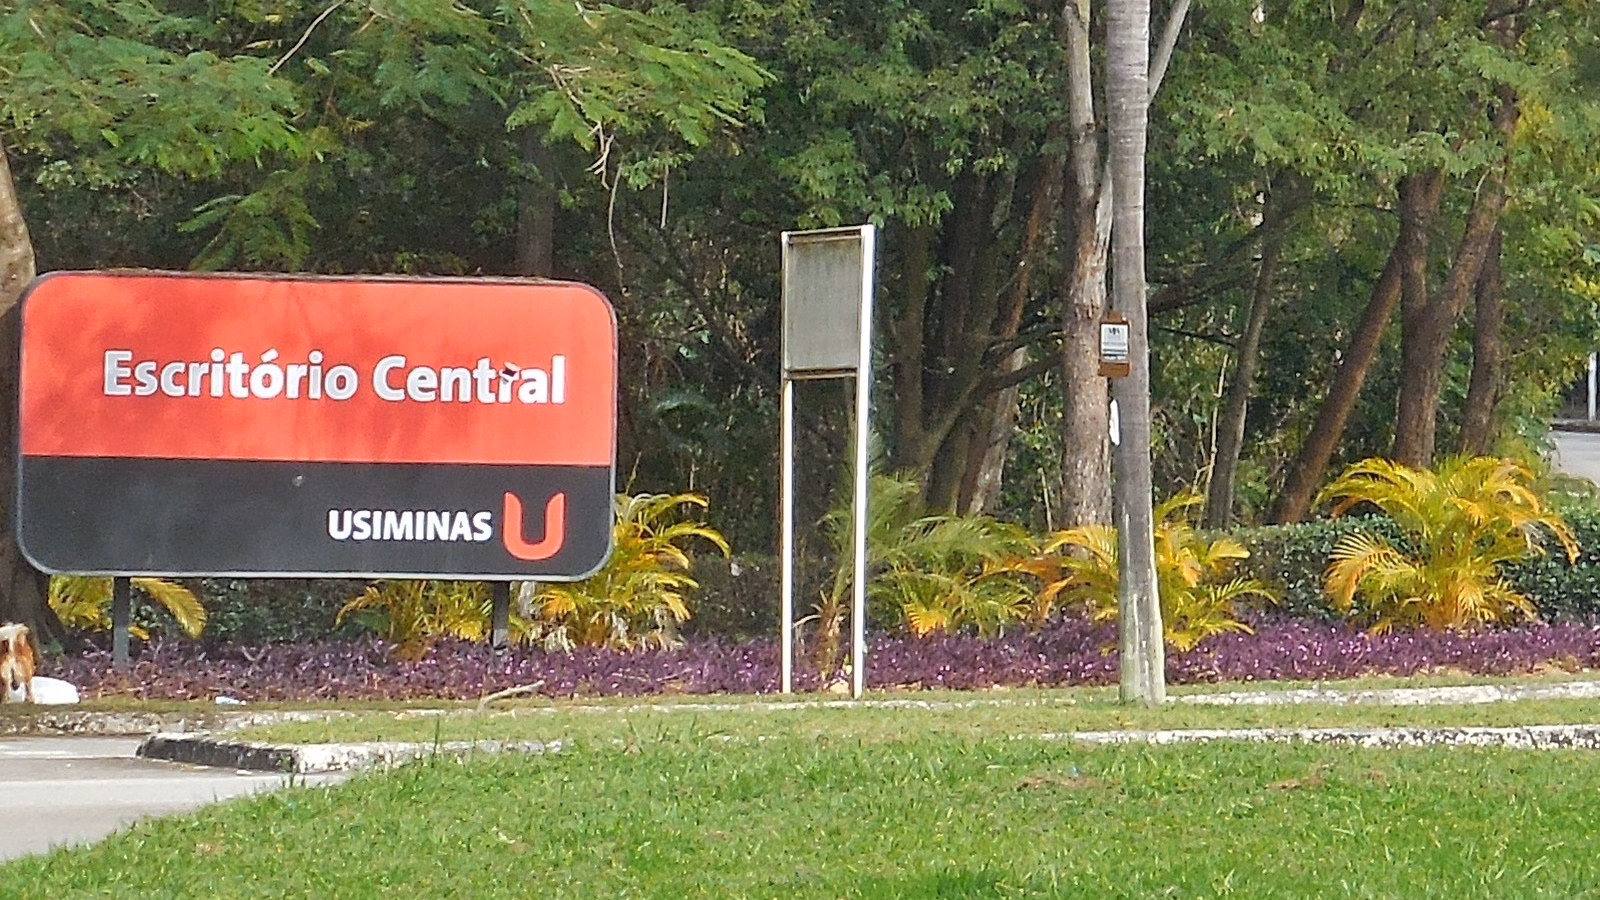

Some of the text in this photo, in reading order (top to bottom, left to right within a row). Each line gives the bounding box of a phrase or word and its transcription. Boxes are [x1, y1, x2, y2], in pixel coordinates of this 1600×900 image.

[103, 348, 566, 404] Escritório Central
[328, 508, 492, 542] USIMINAS
